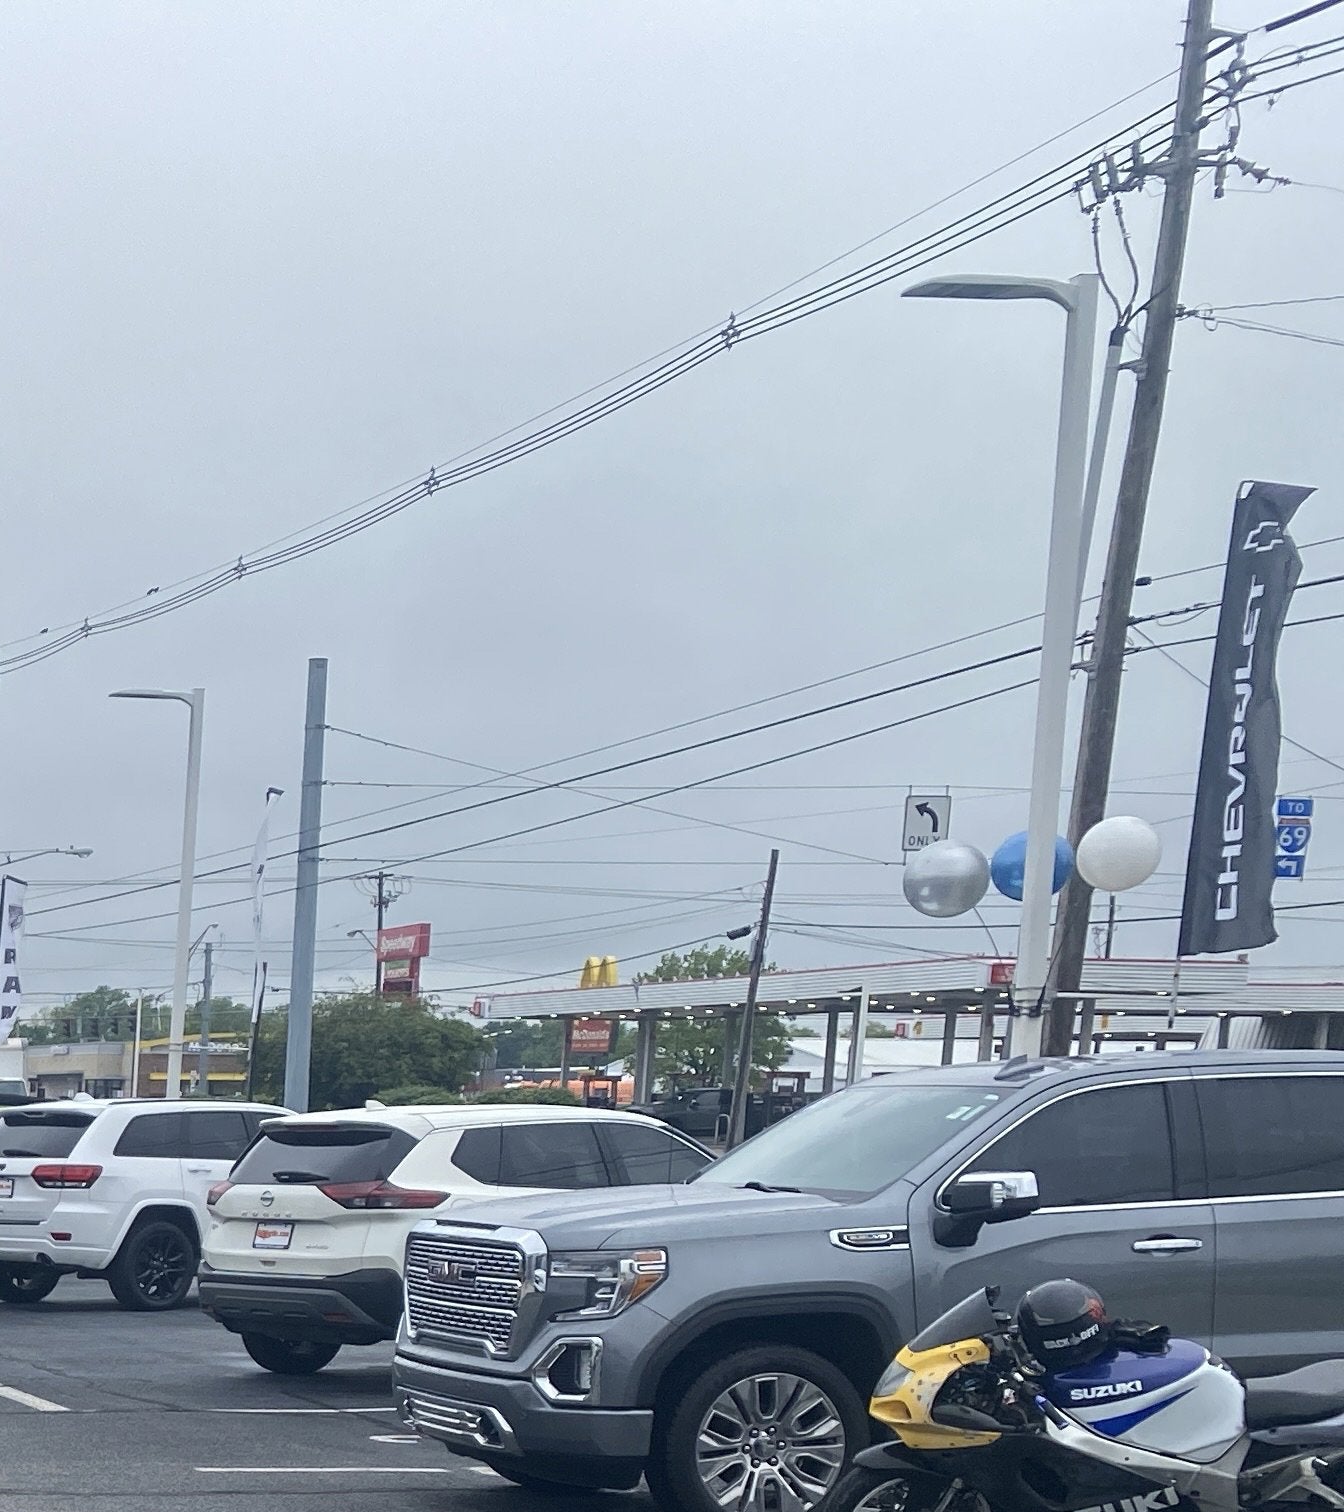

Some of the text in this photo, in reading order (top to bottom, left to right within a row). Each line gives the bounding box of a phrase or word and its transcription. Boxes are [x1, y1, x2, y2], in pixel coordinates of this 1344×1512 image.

[1287, 802, 1304, 813] TO
[1279, 827, 1307, 847] 69
[1070, 1380, 1143, 1400] SUZUKI
